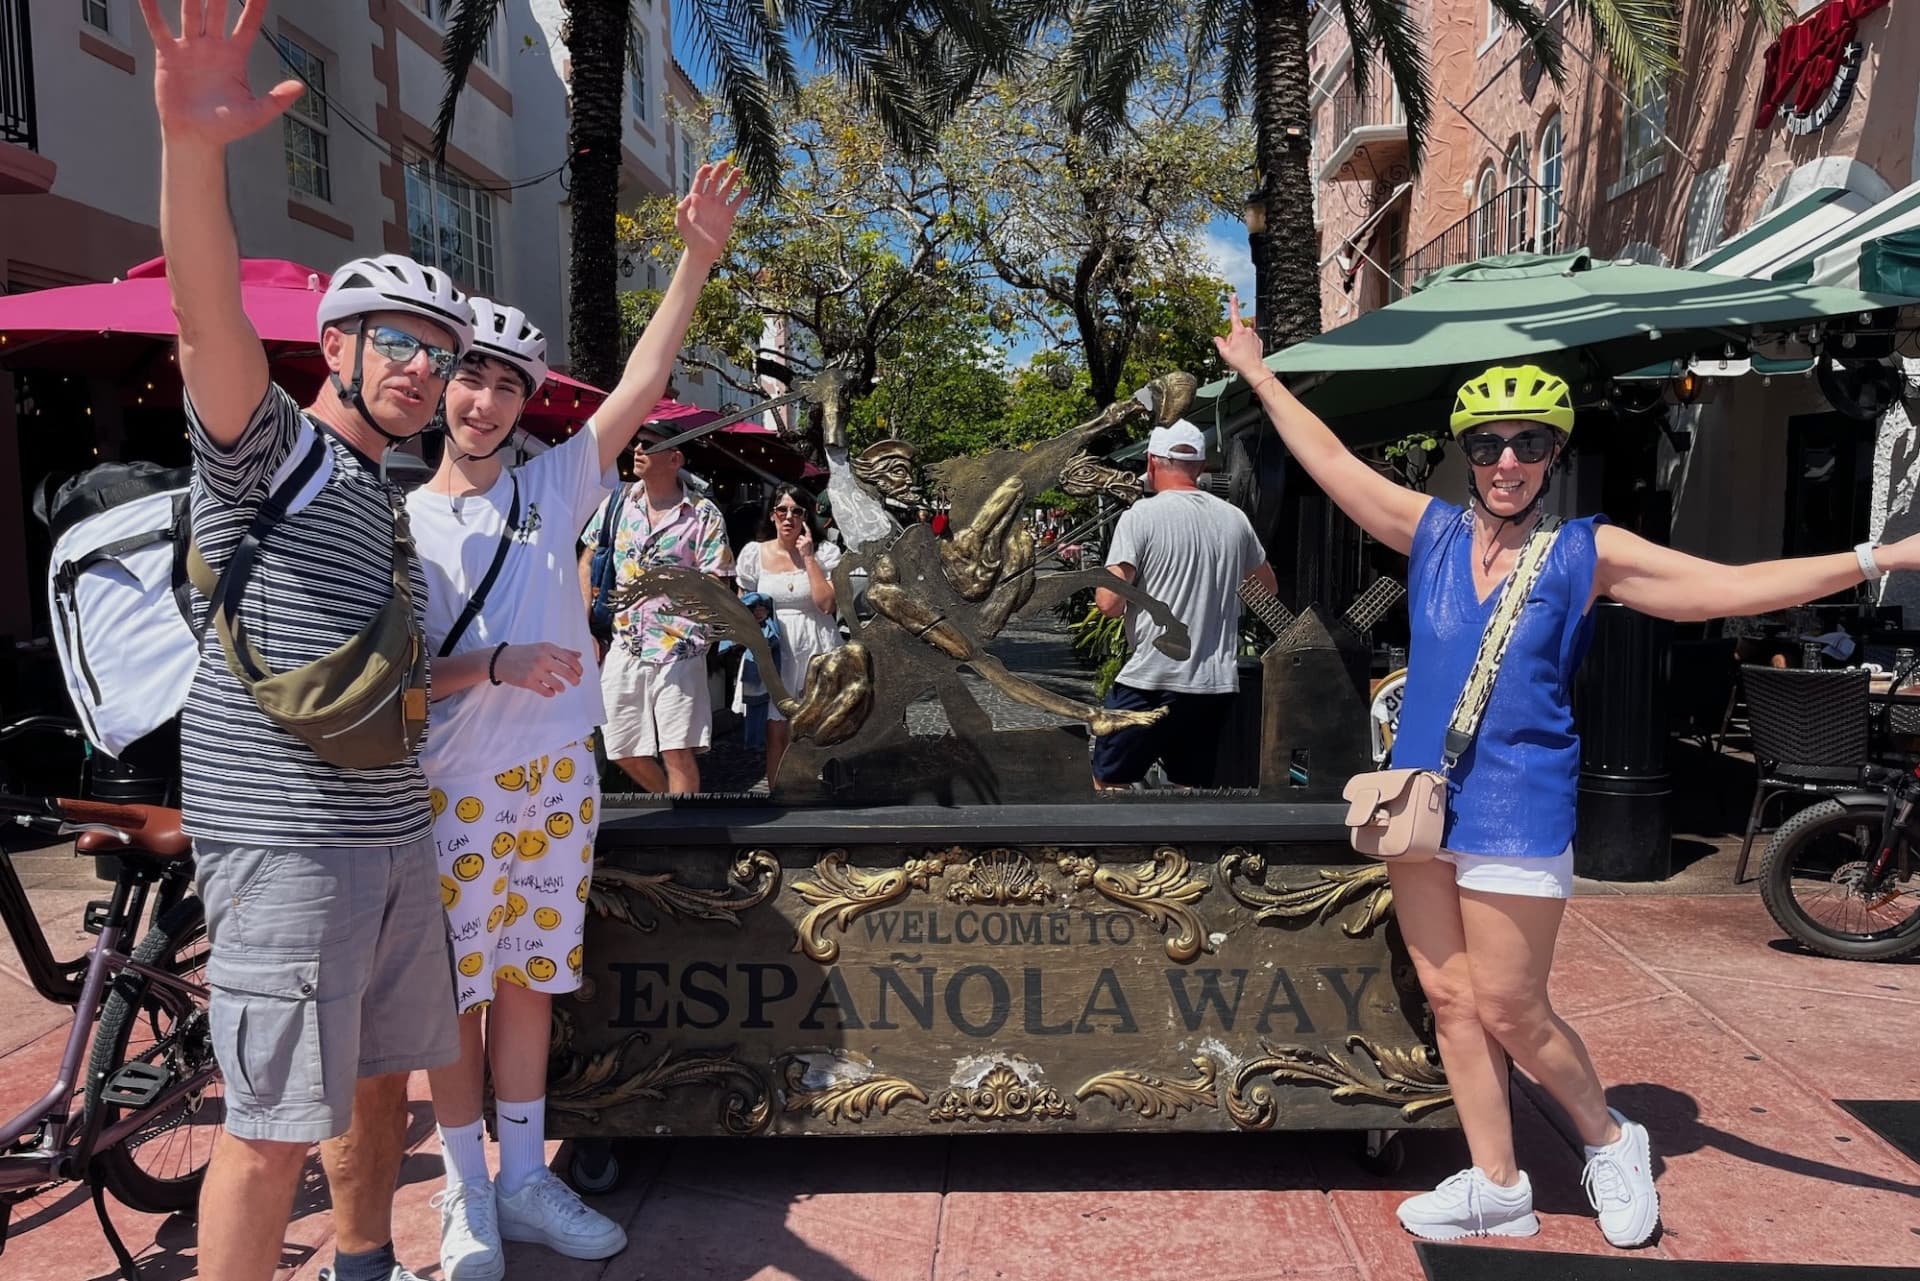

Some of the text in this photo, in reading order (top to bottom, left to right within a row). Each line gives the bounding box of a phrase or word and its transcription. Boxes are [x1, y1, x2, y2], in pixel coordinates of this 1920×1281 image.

[864, 910, 1134, 945] WELCOME TO
[607, 952, 1381, 1038] ESPAÑOLA WAY
